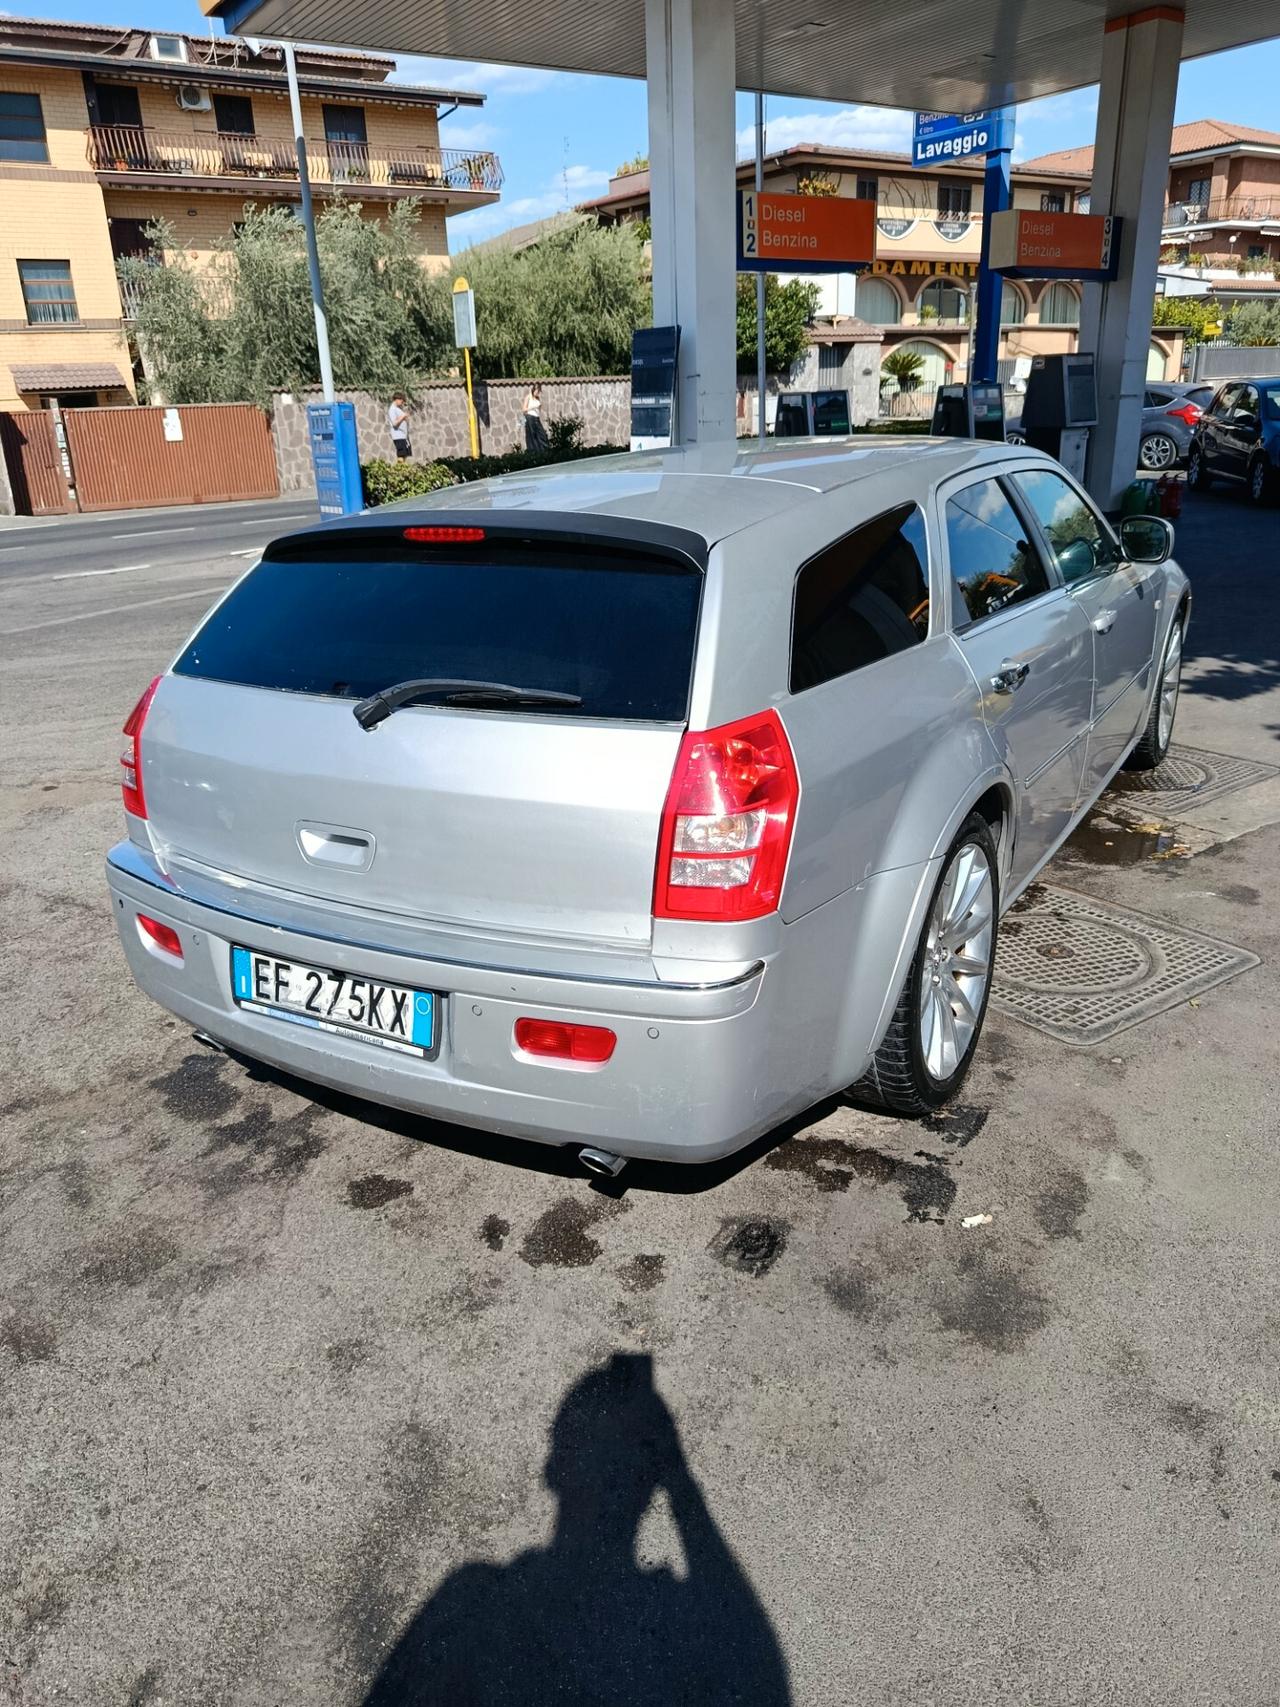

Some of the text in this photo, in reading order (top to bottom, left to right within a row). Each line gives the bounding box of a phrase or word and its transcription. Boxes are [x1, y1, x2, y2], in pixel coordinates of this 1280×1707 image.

[917, 129, 988, 160] Lavaggio
[746, 196, 752, 216] 1
[762, 204, 806, 223] Diesel
[1022, 220, 1055, 236] Diesel
[1104, 218, 1111, 234] 3
[746, 233, 755, 252] 2
[762, 230, 818, 249] Benzina
[1020, 242, 1062, 258] Benzina
[1101, 251, 1108, 267] 4
[254, 957, 292, 1002] EF
[305, 971, 408, 1036] 275KX
